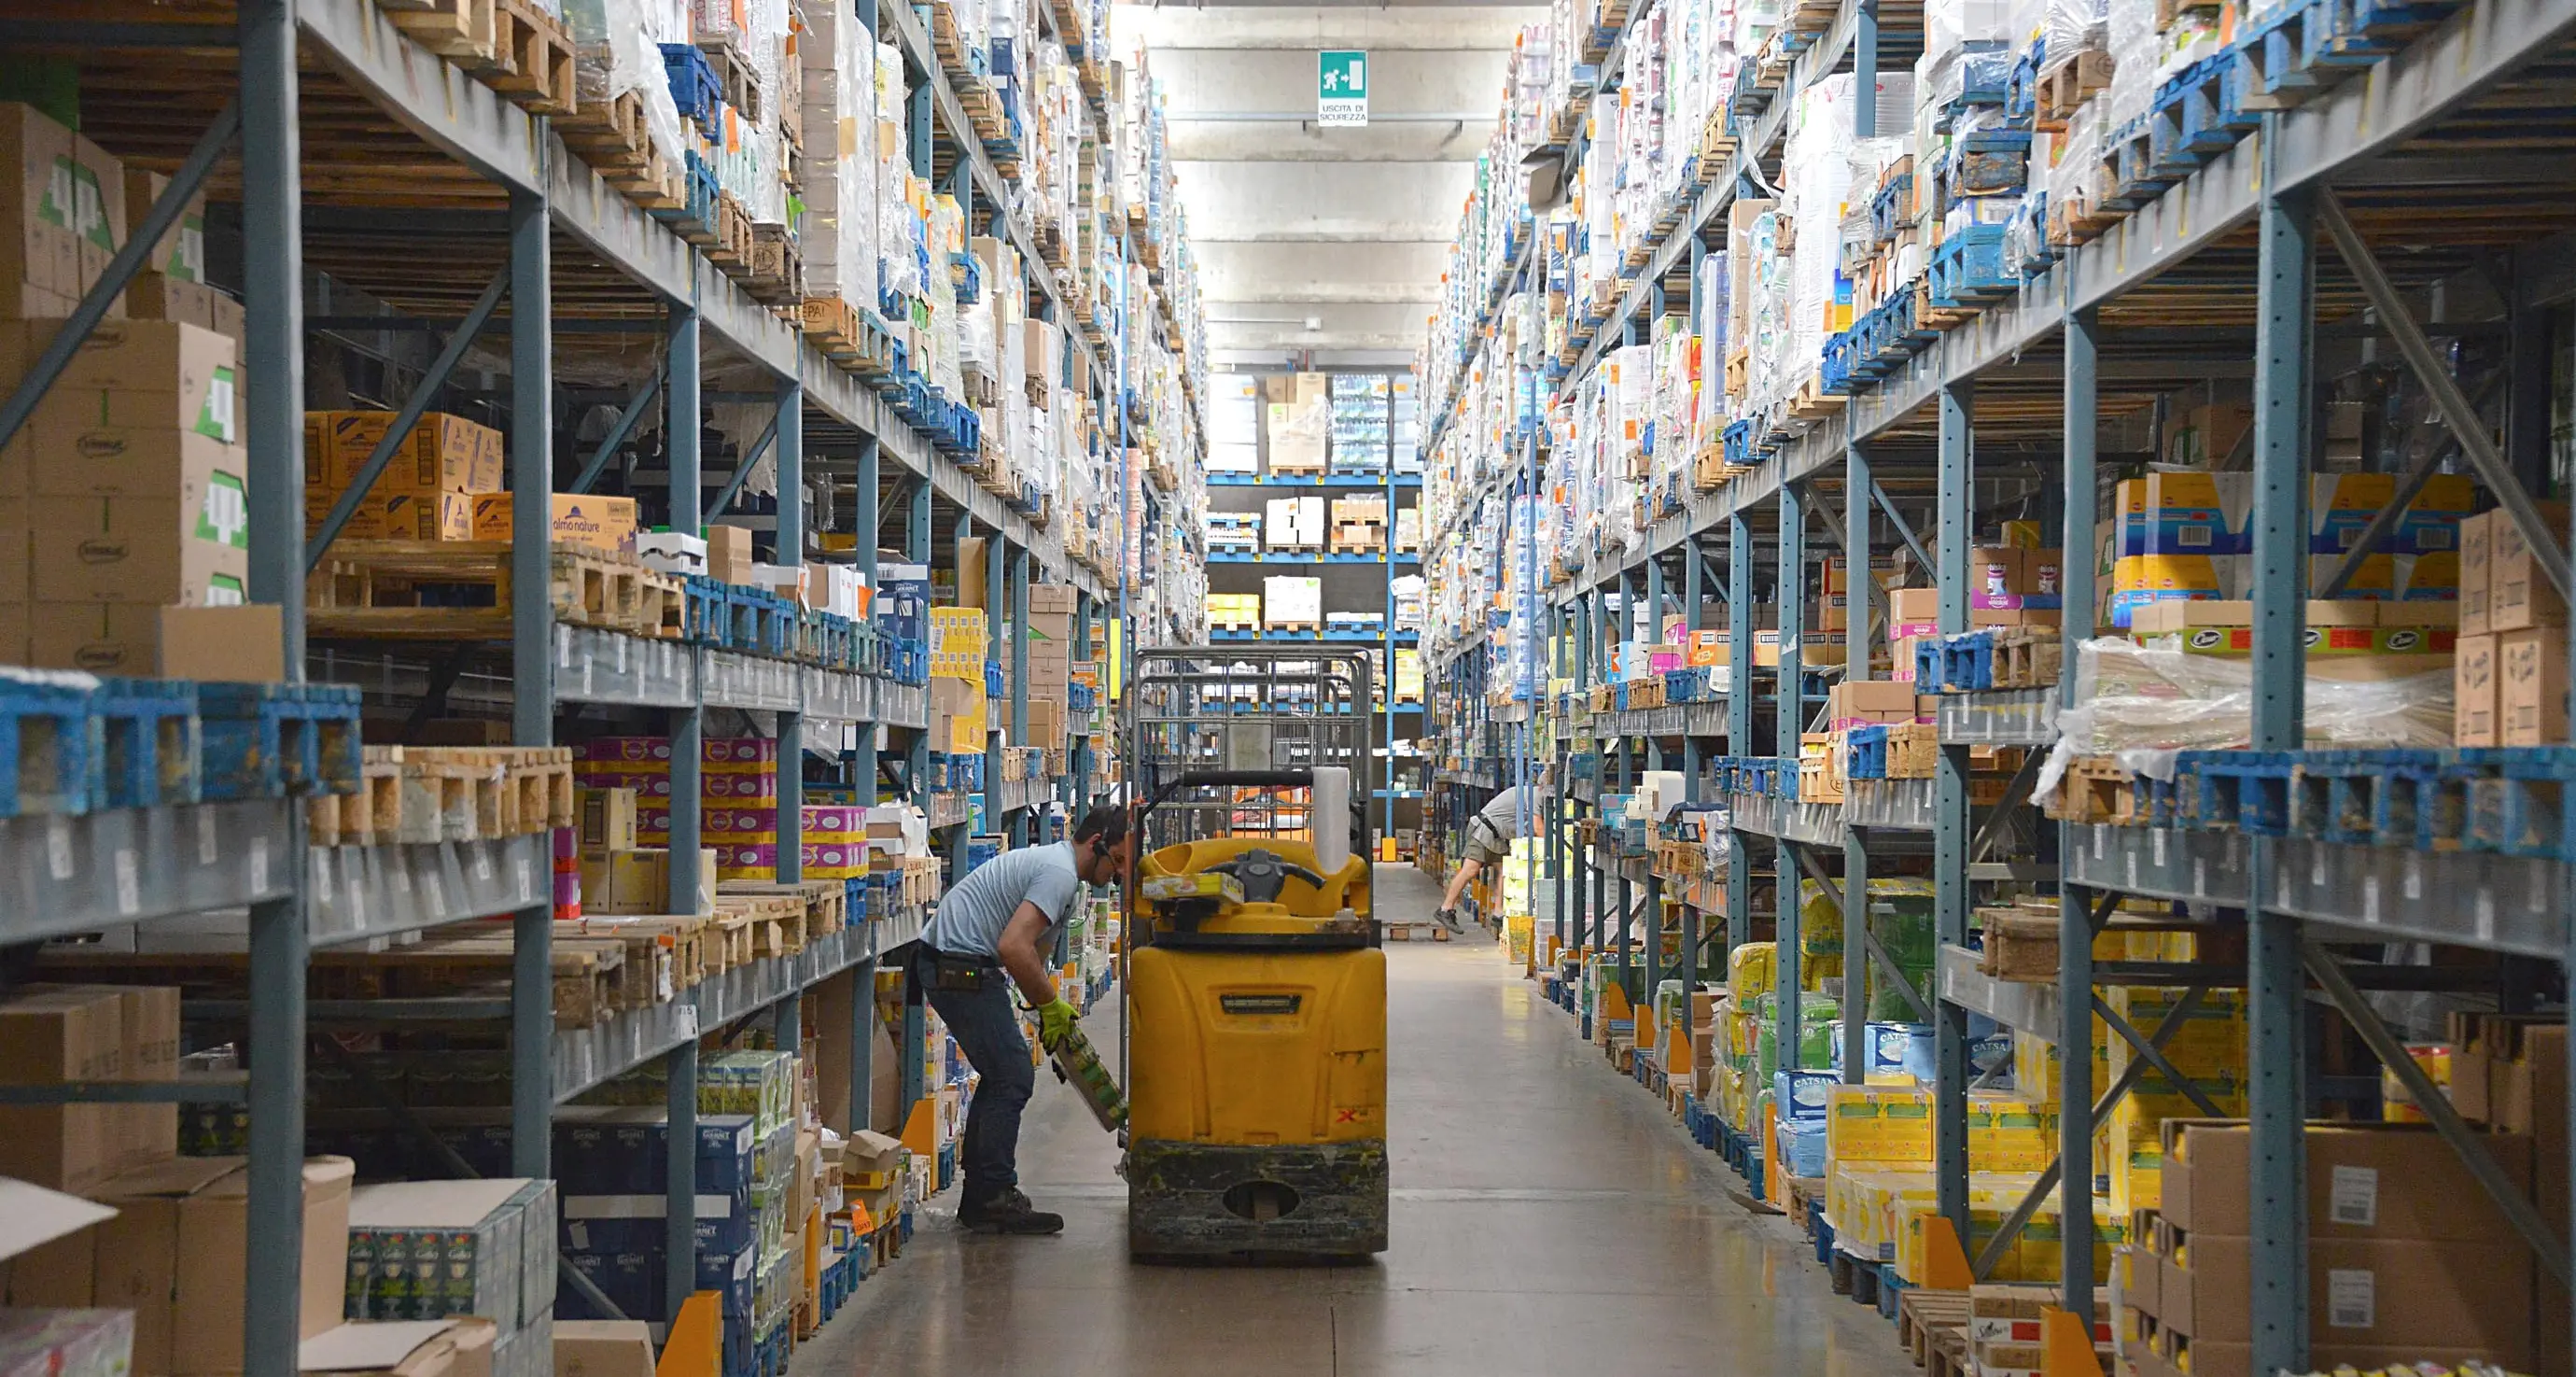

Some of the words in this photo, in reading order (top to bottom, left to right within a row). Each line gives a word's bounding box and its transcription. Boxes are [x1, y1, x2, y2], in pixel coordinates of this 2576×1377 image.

[1320, 113, 1366, 121] SICUREZZA
[553, 519, 574, 530] almo
[574, 520, 600, 533] nature
[1971, 1042, 2007, 1052] CATSA
